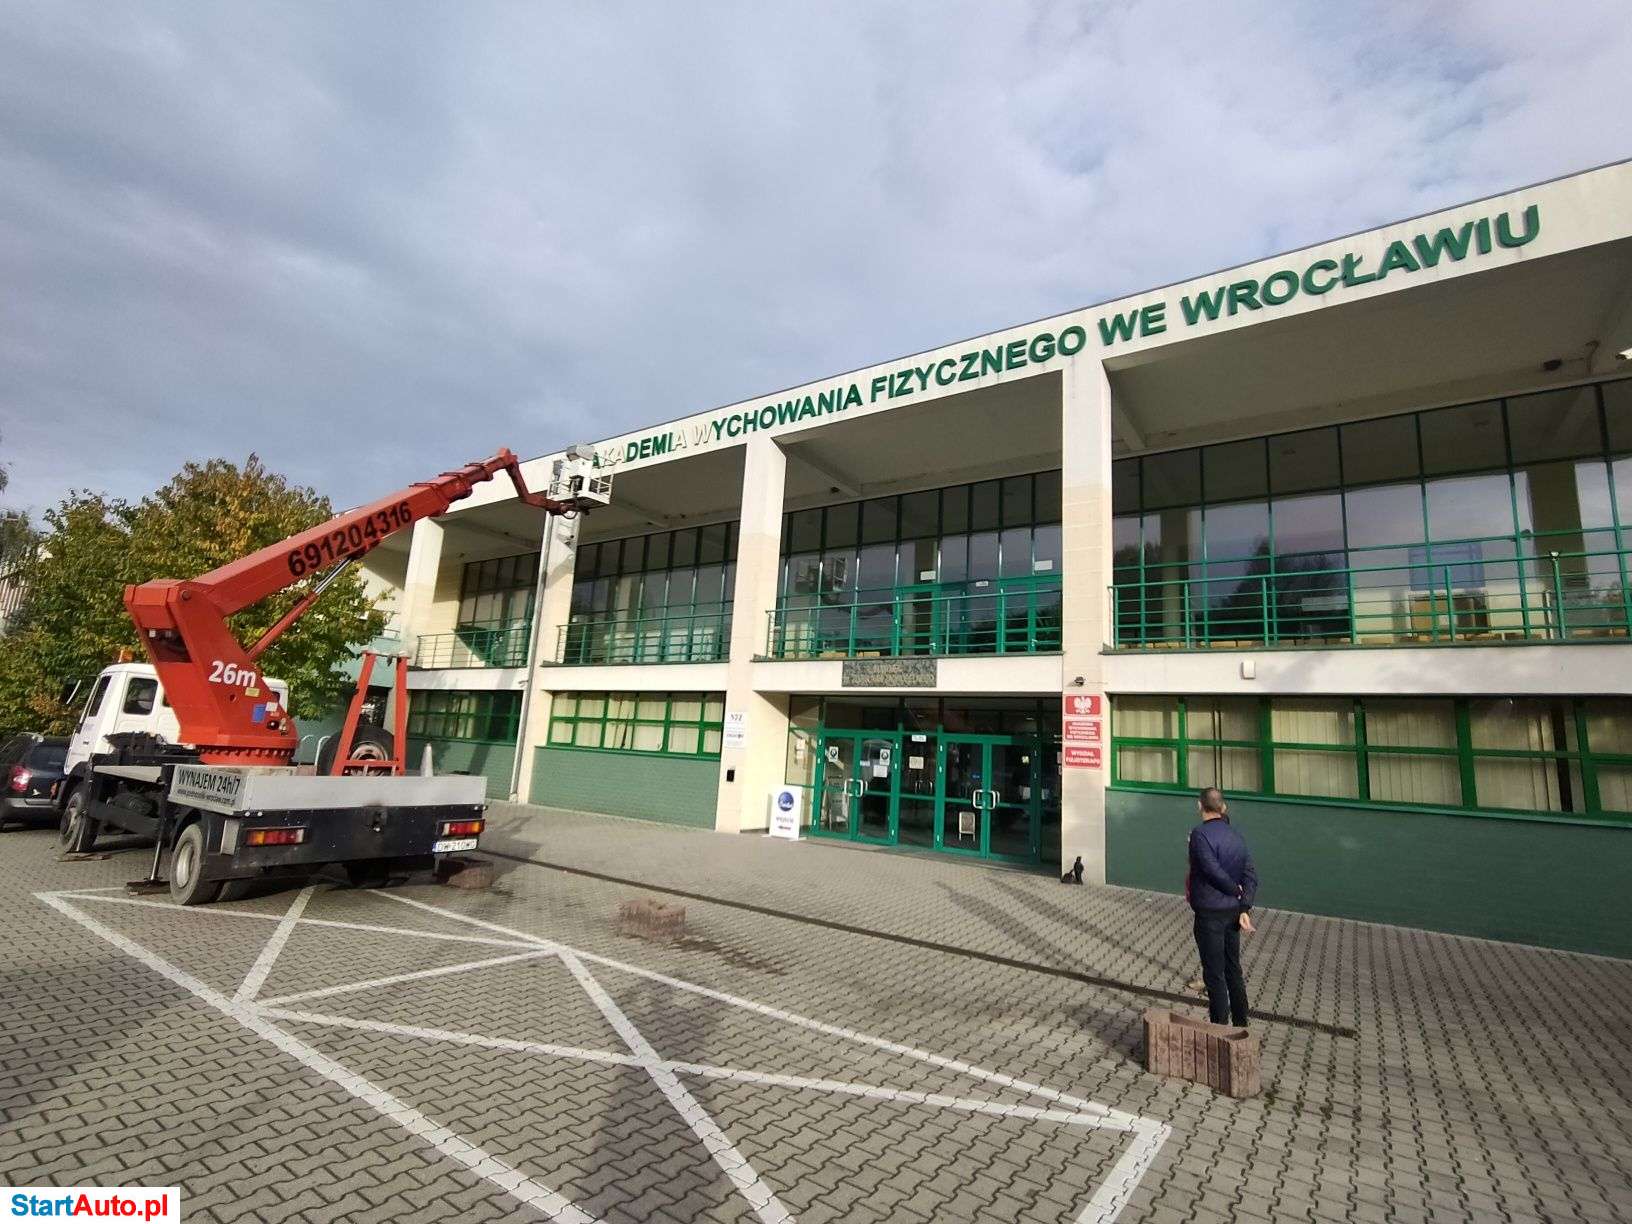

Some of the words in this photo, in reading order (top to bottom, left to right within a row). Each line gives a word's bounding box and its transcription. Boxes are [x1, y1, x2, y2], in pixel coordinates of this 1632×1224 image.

[694, 384, 863, 446] WYCHOWANIA
[870, 325, 1087, 403] FIZYCZNEGO
[1096, 302, 1167, 347] WE
[1180, 204, 1541, 327] WROCŁAWIU
[288, 501, 412, 577] 691204316
[208, 660, 256, 688] 26m
[178, 769, 217, 791] WYNAJEM
[217, 775, 241, 795] 24h/7
